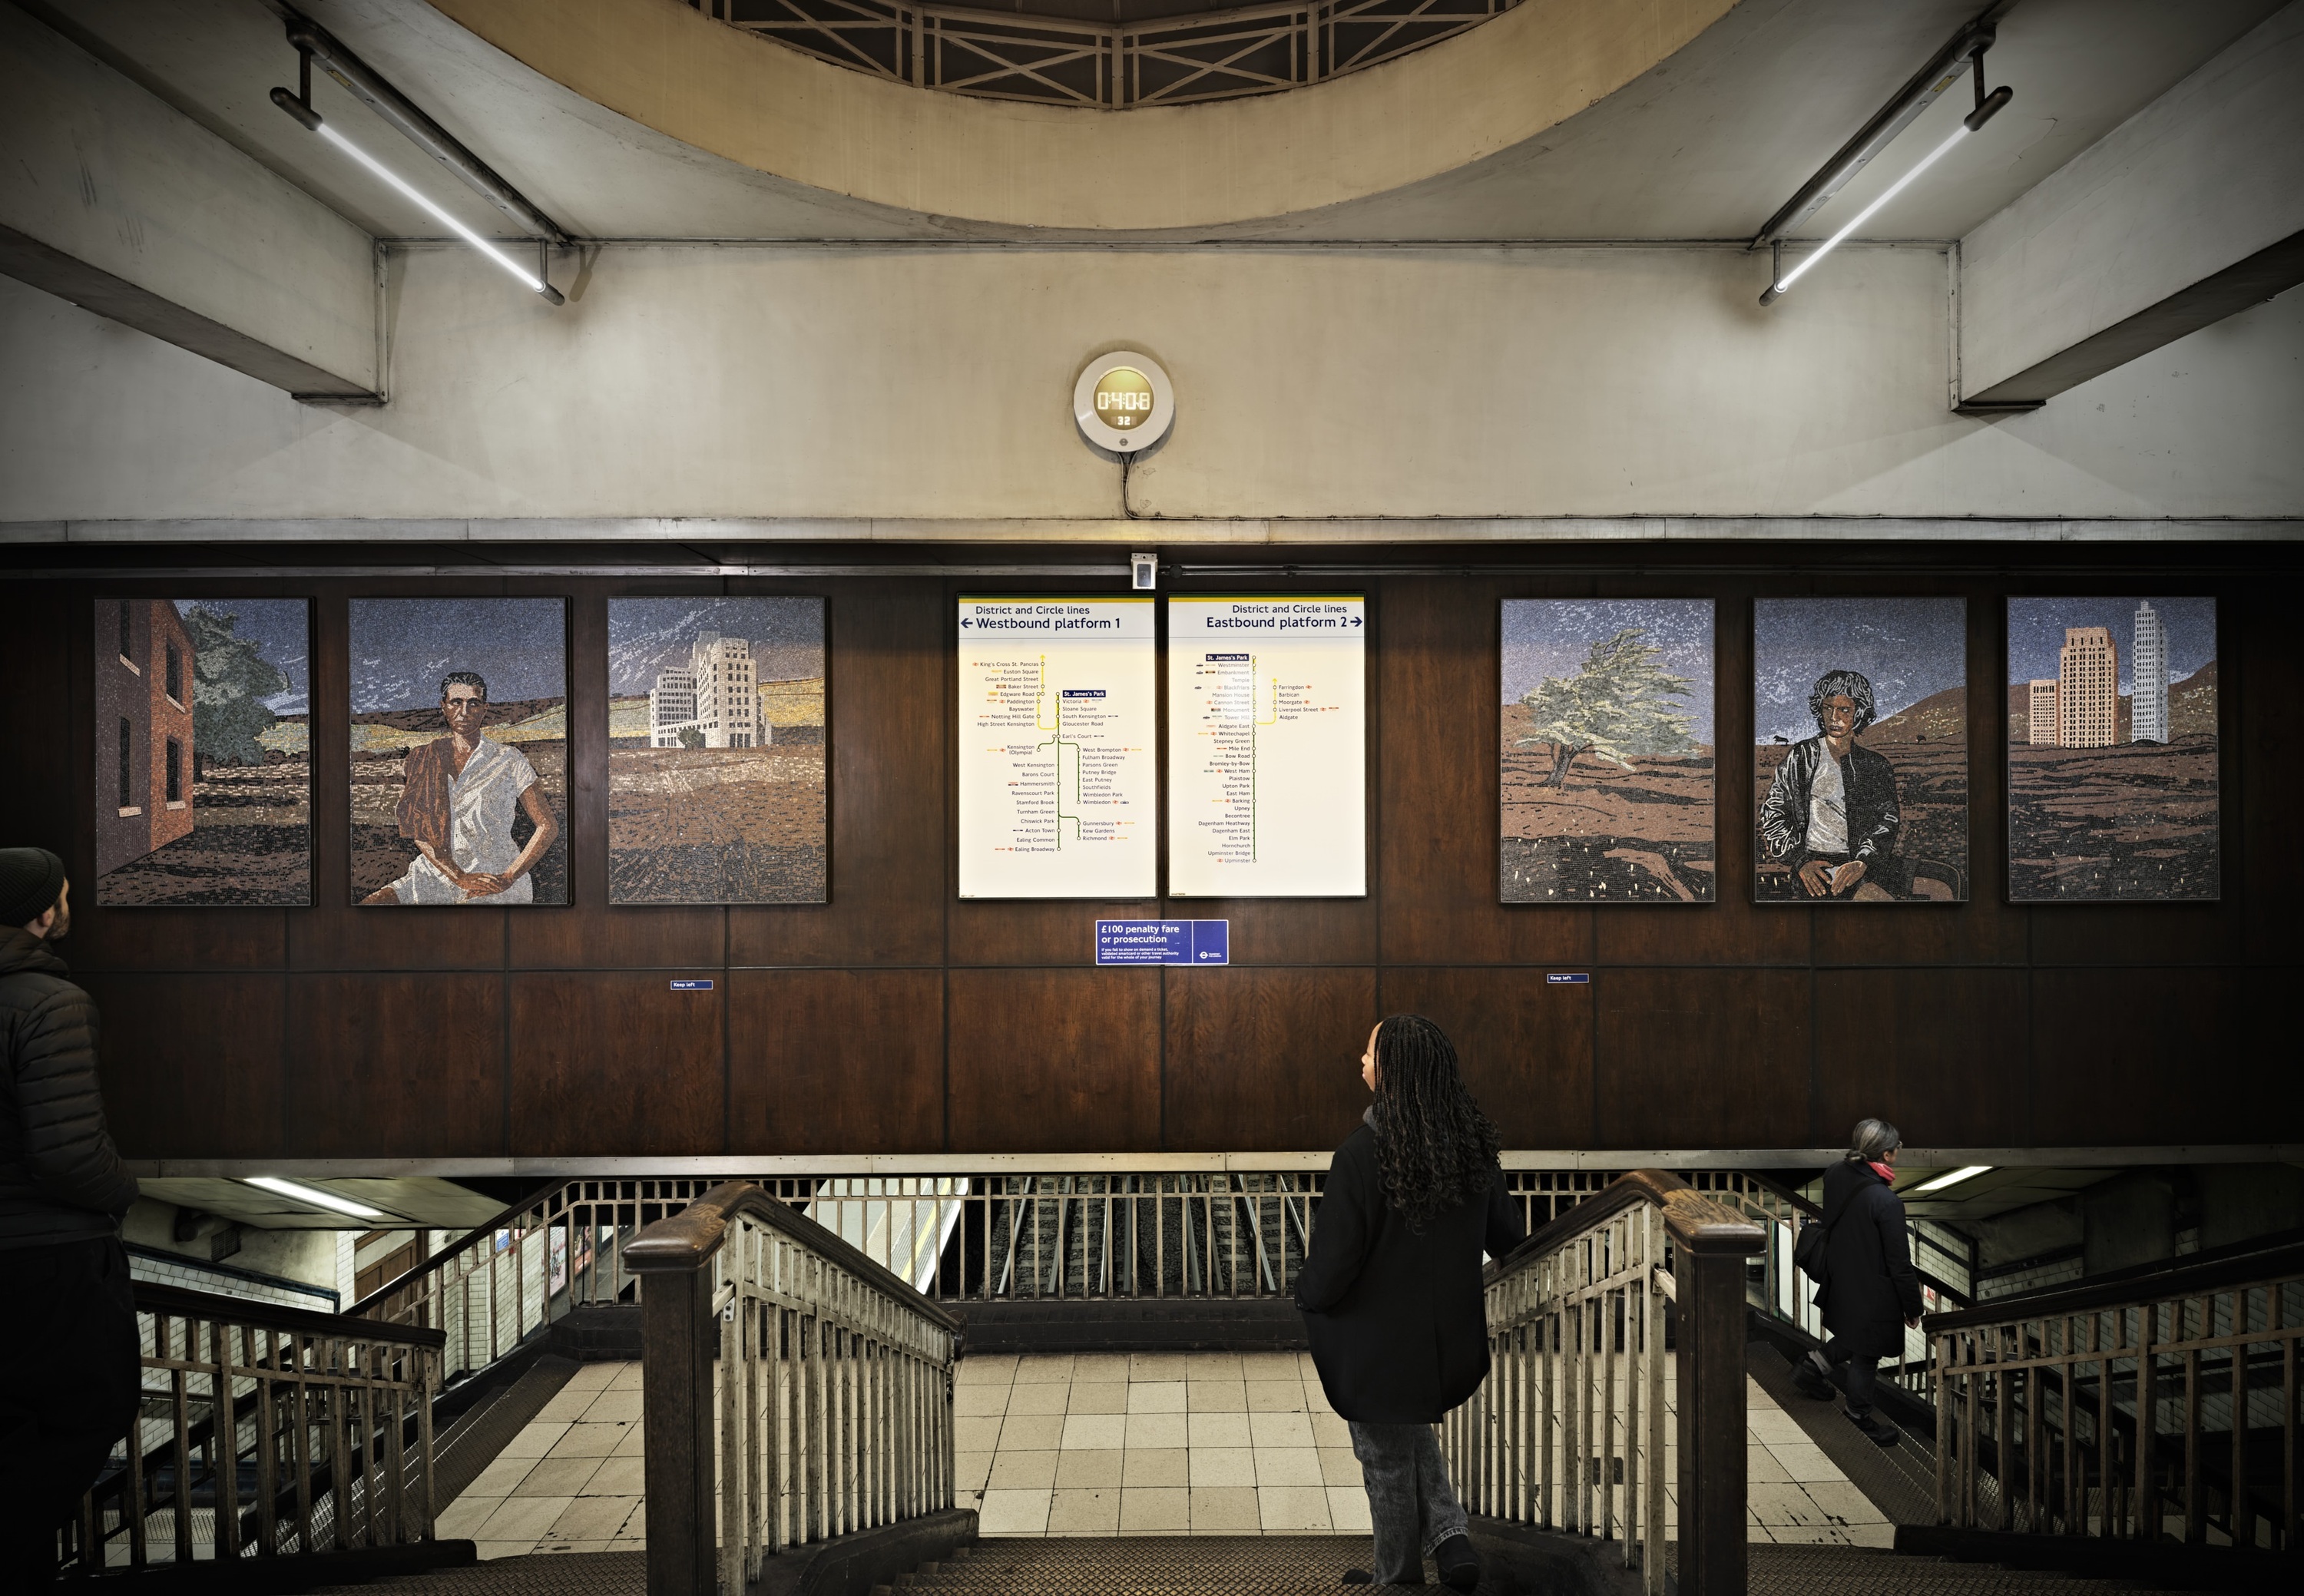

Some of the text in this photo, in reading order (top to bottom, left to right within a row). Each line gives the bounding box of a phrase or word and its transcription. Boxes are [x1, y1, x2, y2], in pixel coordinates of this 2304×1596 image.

[1117, 416, 1130, 425] 32
[976, 606, 1091, 614] District and Circle lines
[1233, 605, 1269, 614] District
[1273, 605, 1289, 614] and
[1293, 605, 1321, 614] Circle
[976, 618, 1120, 631] Westbound platform 1
[1207, 617, 1347, 630] Eastbound platform 2
[1101, 925, 1180, 935] £100 penalty fare
[1114, 935, 1167, 945] prosecution
